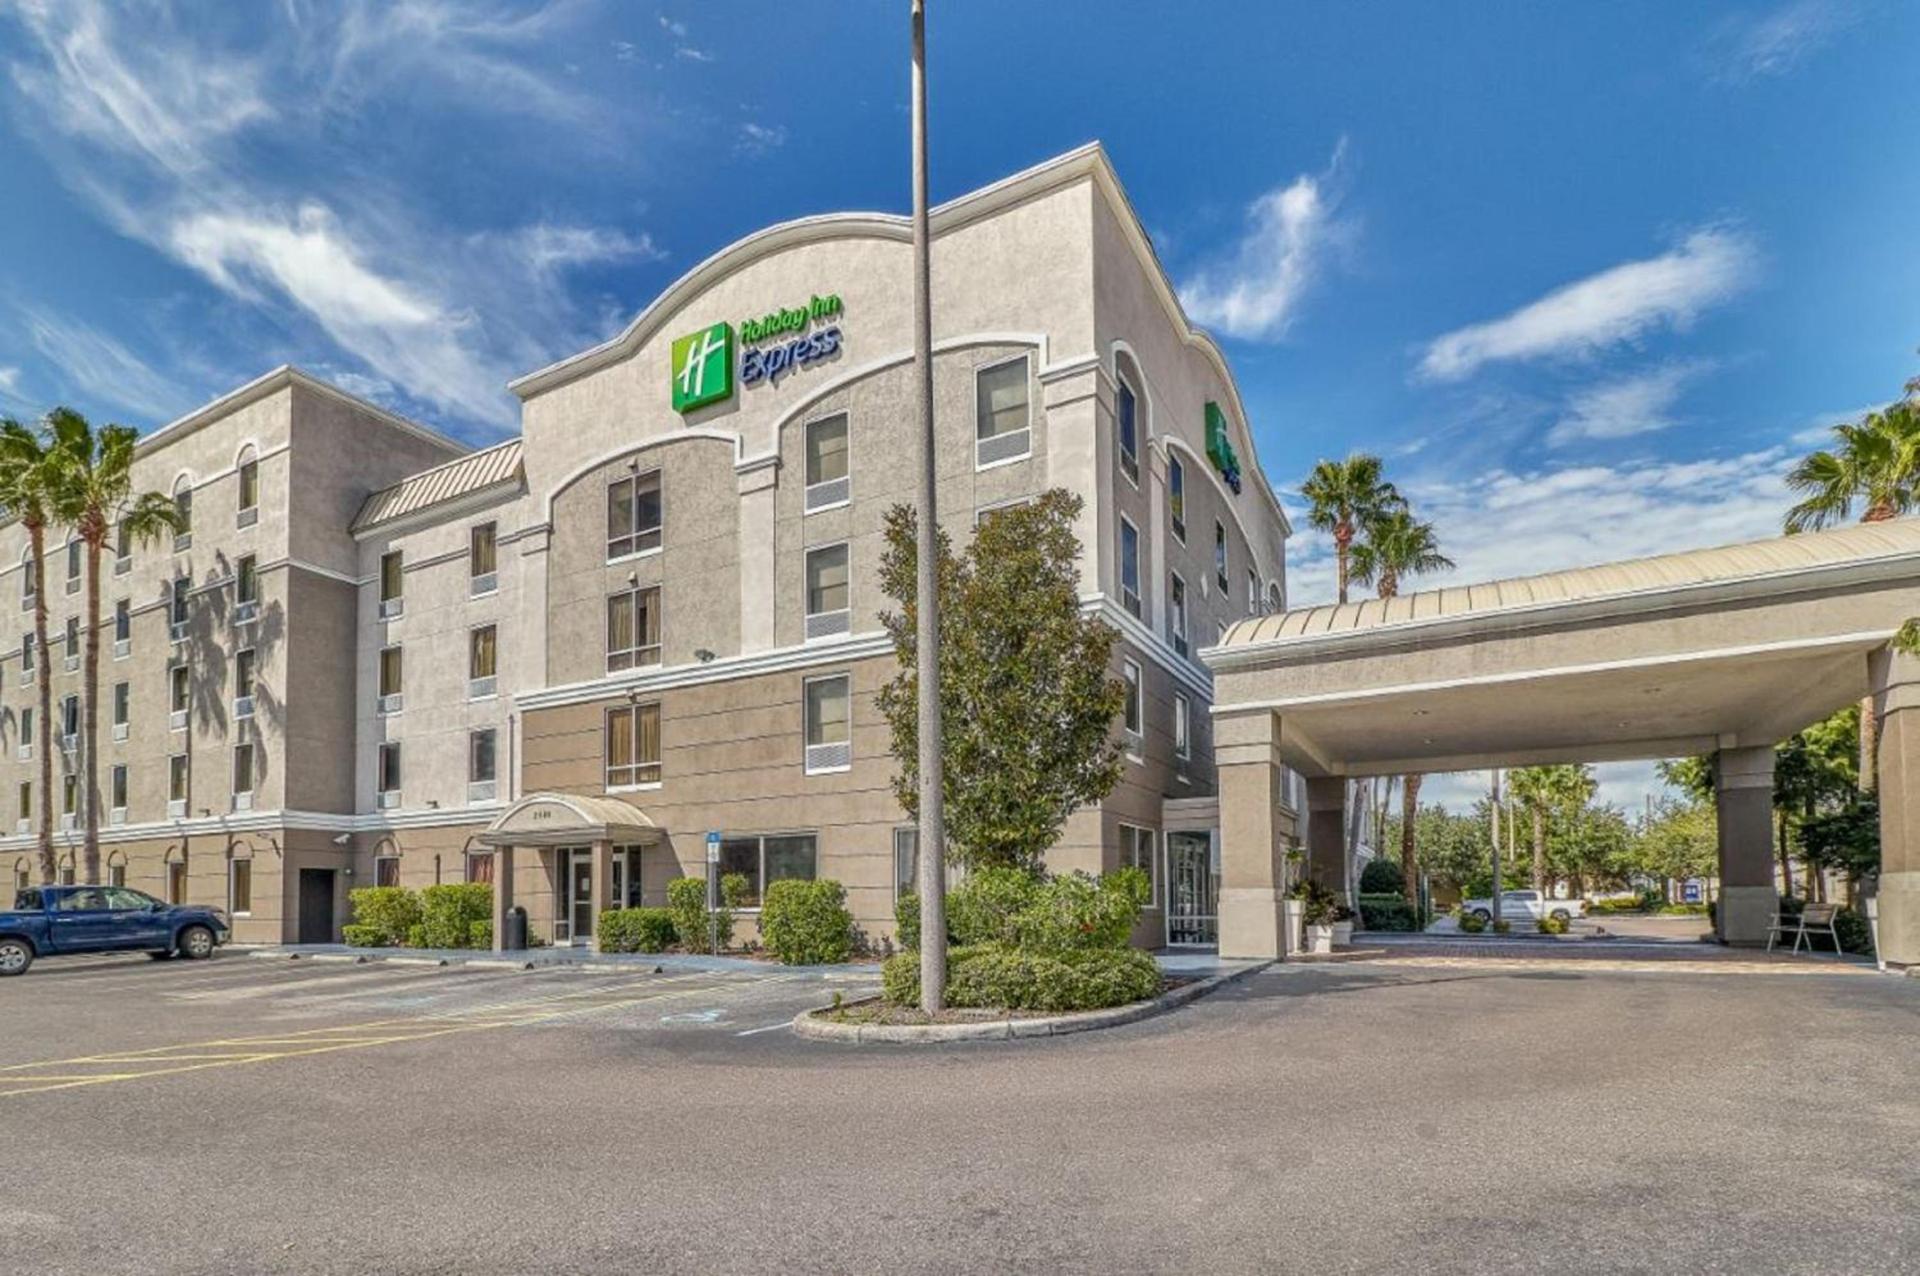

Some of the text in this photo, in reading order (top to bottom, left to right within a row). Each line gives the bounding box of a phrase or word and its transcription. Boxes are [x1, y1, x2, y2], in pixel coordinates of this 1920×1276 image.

[740, 294, 842, 344] Holiday Inn
[676, 330, 725, 396] H
[738, 326, 843, 385] Express
